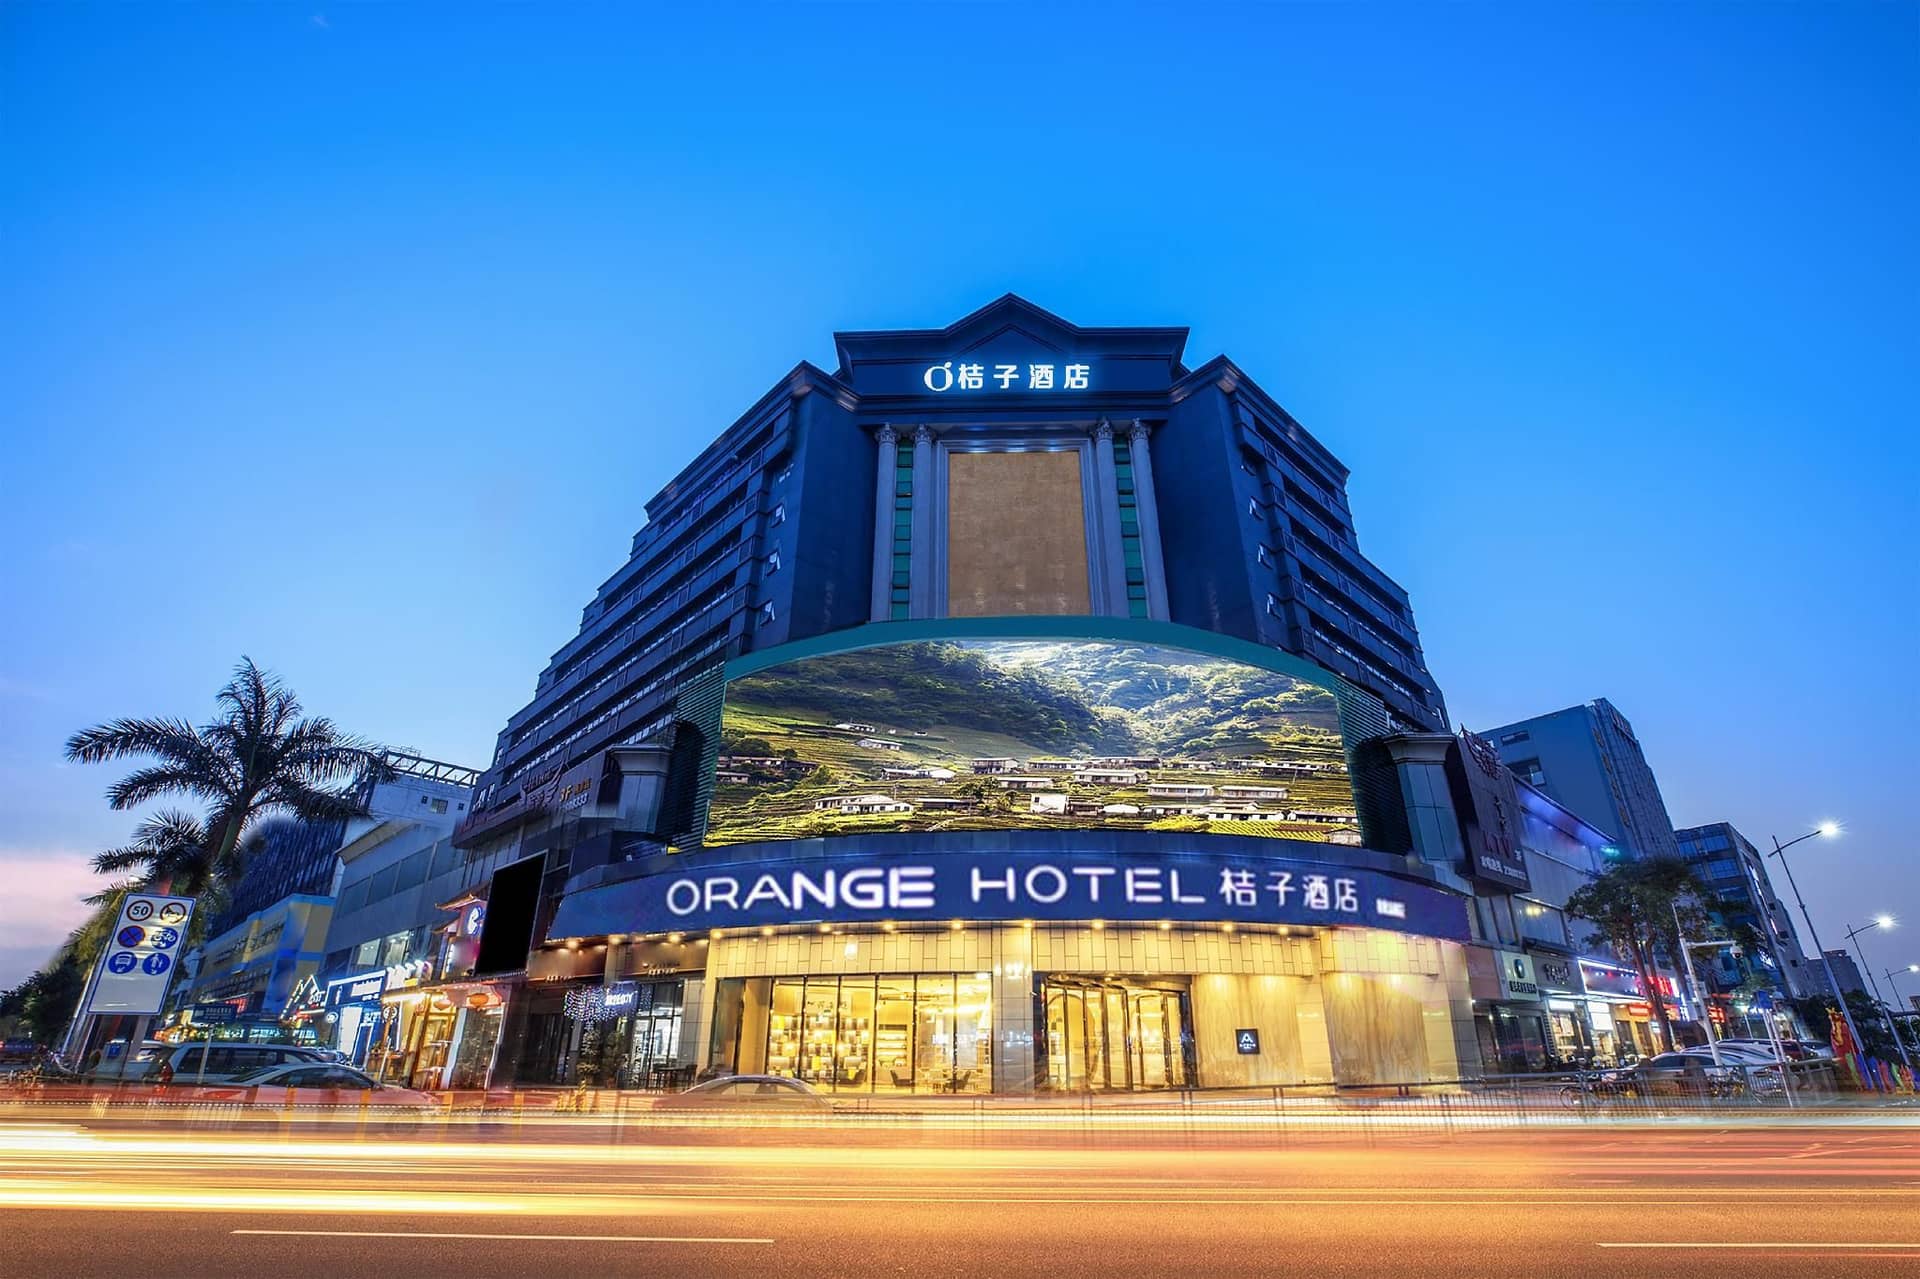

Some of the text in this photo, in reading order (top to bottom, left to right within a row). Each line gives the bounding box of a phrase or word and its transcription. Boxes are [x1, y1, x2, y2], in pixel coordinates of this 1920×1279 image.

[958, 363, 1090, 390] 桔子酒店
[666, 865, 1206, 916] ORANGE HOTEL
[1218, 867, 1359, 912] 桔子酒店
[132, 905, 149, 916] 50
